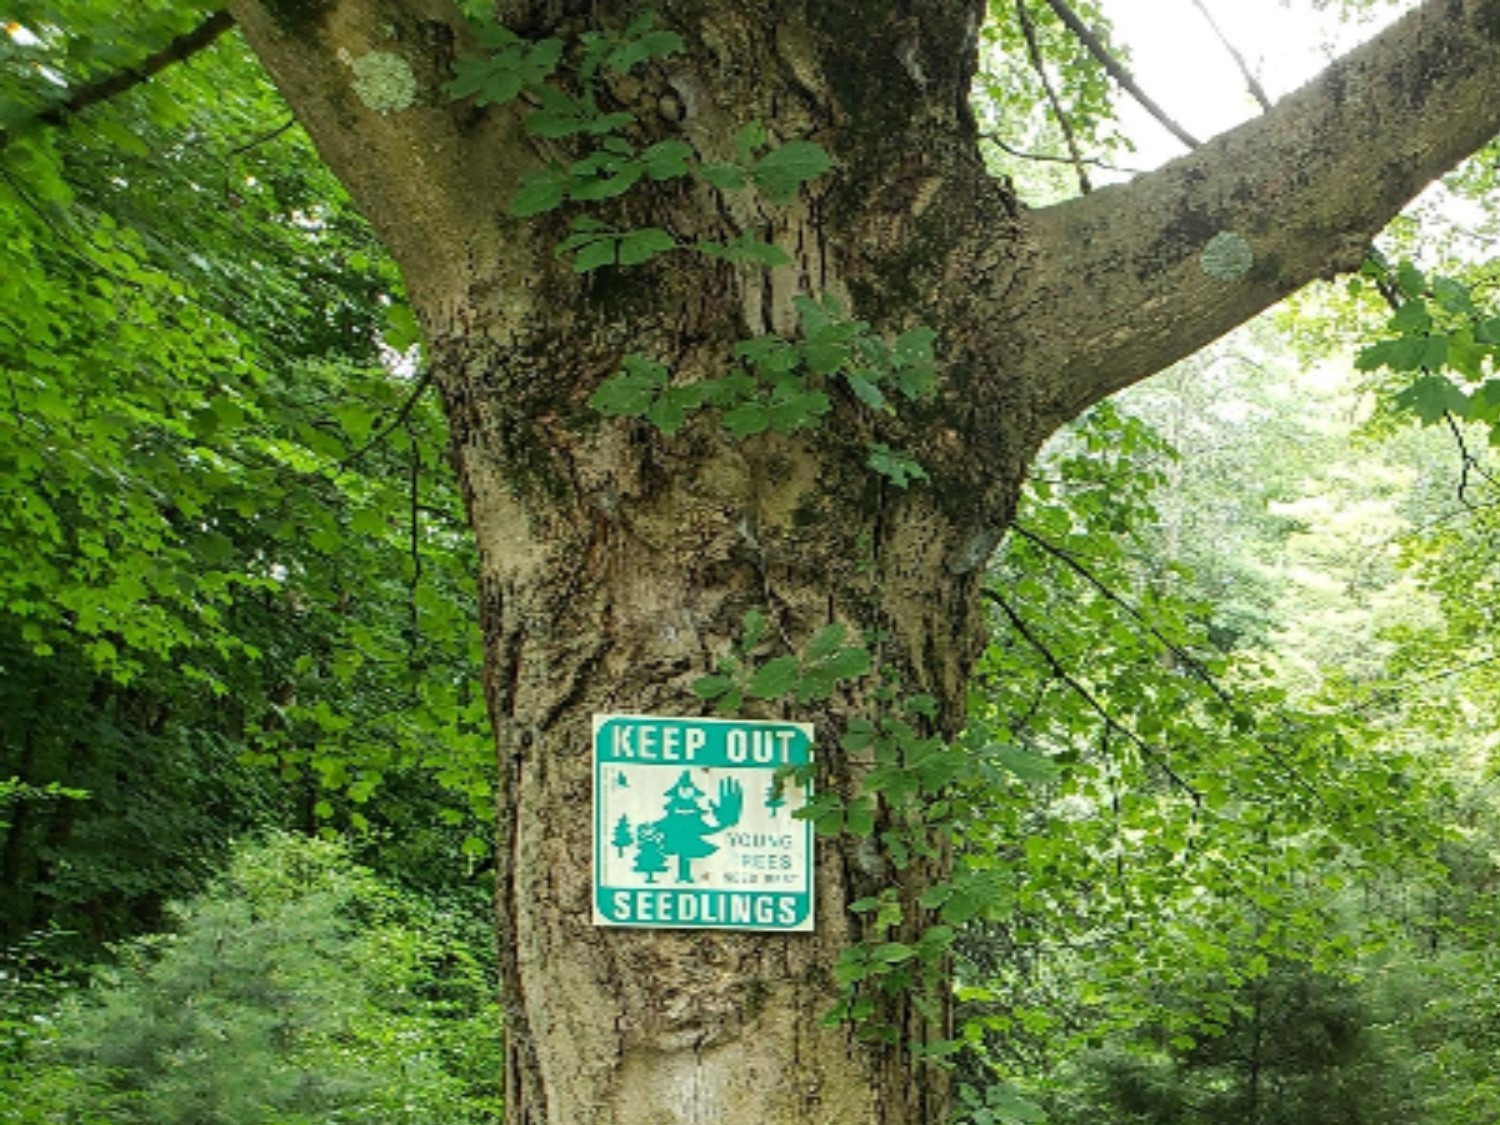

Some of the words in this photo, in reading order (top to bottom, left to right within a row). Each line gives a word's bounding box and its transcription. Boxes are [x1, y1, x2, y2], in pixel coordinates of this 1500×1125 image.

[612, 725, 705, 761] KEEP
[727, 729, 796, 763] OUT
[731, 854, 793, 870] REES
[612, 892, 797, 924] SEEDLINGS
